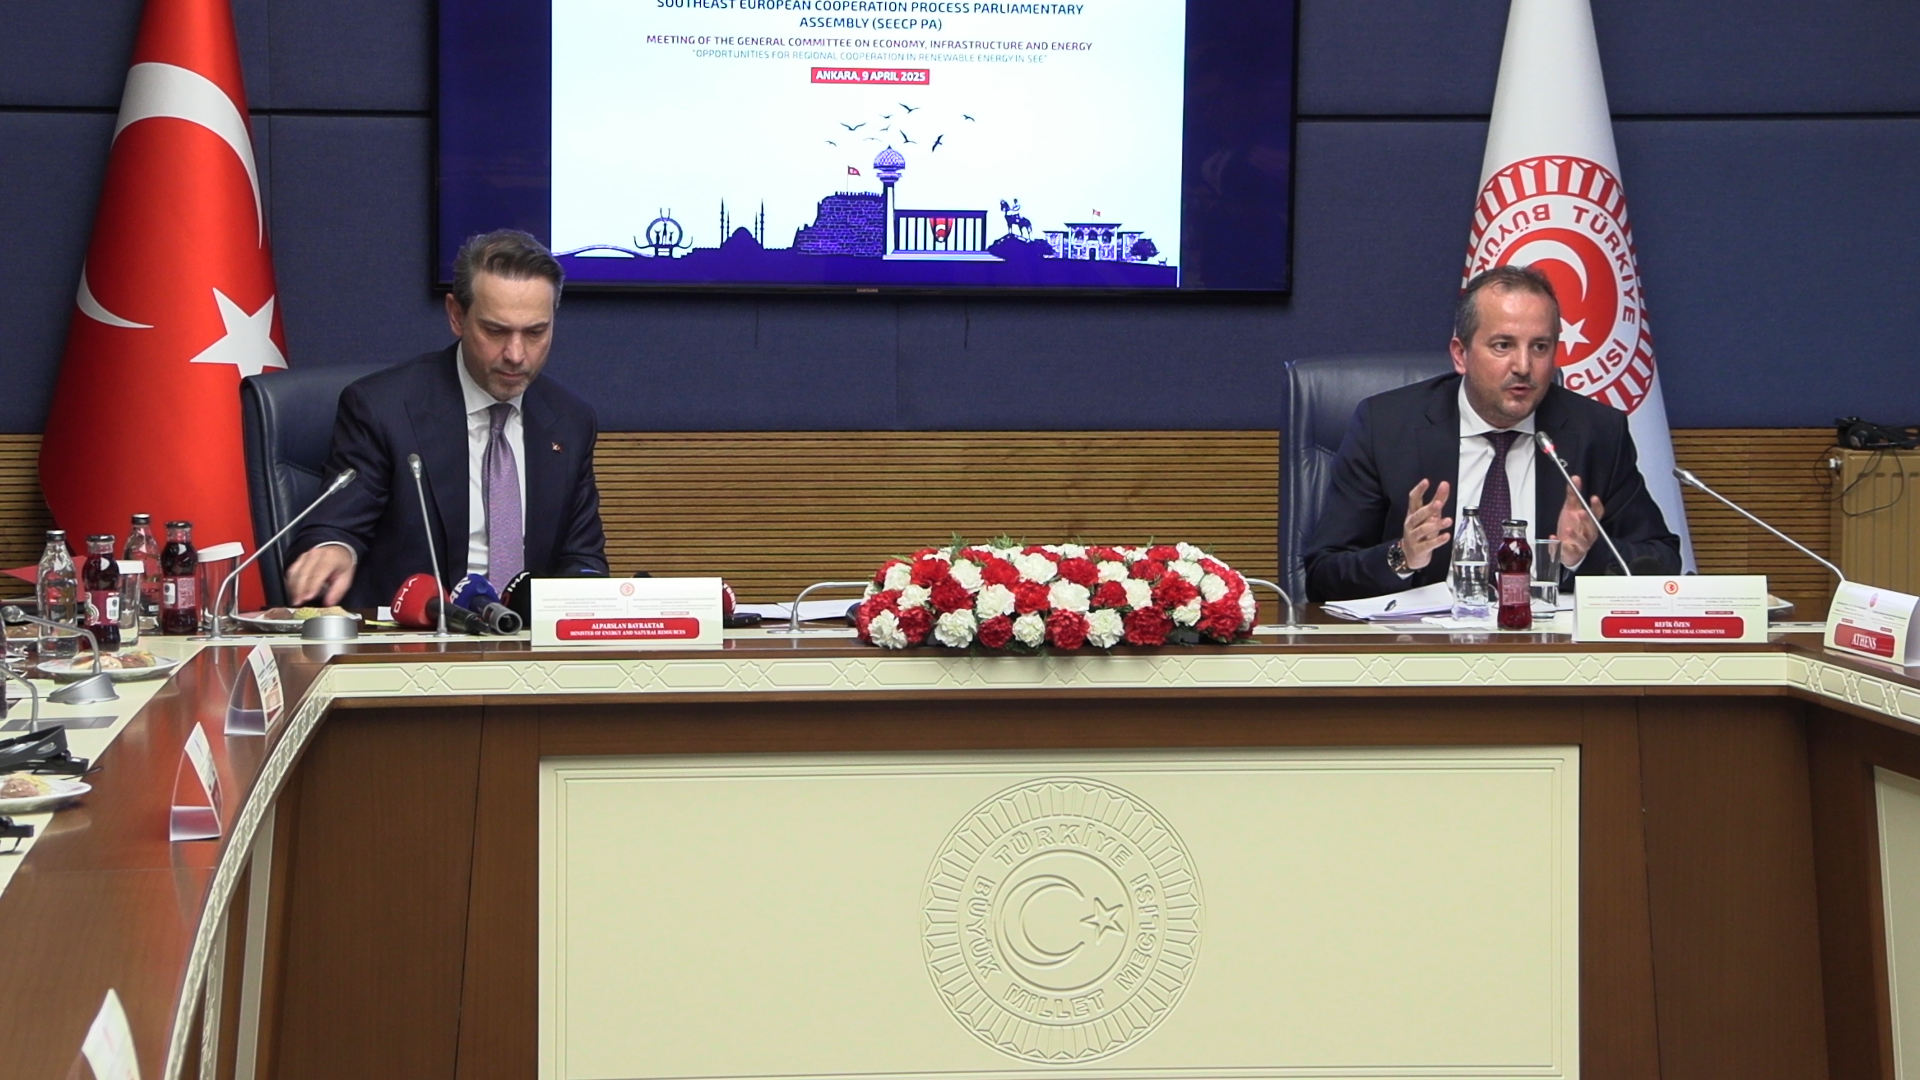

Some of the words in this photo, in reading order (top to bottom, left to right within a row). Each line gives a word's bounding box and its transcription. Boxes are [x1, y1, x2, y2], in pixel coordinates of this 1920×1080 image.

[657, 0, 735, 9] SOUTHEAST
[740, 0, 811, 10] EUROPEAN
[815, 0, 908, 12] COOPERATION
[911, 2, 970, 13] PROCESS
[974, 3, 1084, 15] PARLIAMENTARY
[799, 17, 870, 28] ASSEMBLY
[872, 17, 918, 30] (SEECP
[921, 18, 942, 31] PA)
[646, 35, 695, 44] MEETING
[697, 36, 712, 45] OF
[714, 36, 735, 45] THE
[737, 37, 786, 46] GENERAL
[788, 37, 852, 47] COMMITTEE
[854, 38, 870, 48] ON
[873, 39, 928, 49] ECONOMY,
[930, 40, 1024, 50] INFRASTRUCTURE
[1025, 41, 1049, 50] AND
[1051, 41, 1093, 51] ENERGY
[771, 50, 790, 59] FOR
[792, 51, 838, 60] REGIONAL
[840, 51, 904, 61] COOPERATION
[906, 53, 917, 61] IN
[918, 53, 975, 62] RENEWABLE
[977, 54, 1013, 62] ENERGY
[1015, 54, 1025, 62] IN
[815, 70, 860, 81] ANKARA,
[862, 71, 870, 81] 9
[870, 71, 899, 81] APRIL
[900, 71, 926, 82] 2025
[1851, 633, 1877, 650] ATHENS
[992, 823, 1133, 868] TÜRKİYE
[966, 875, 1002, 981] BÜYÜK
[1003, 983, 1105, 1019] MİLLET
